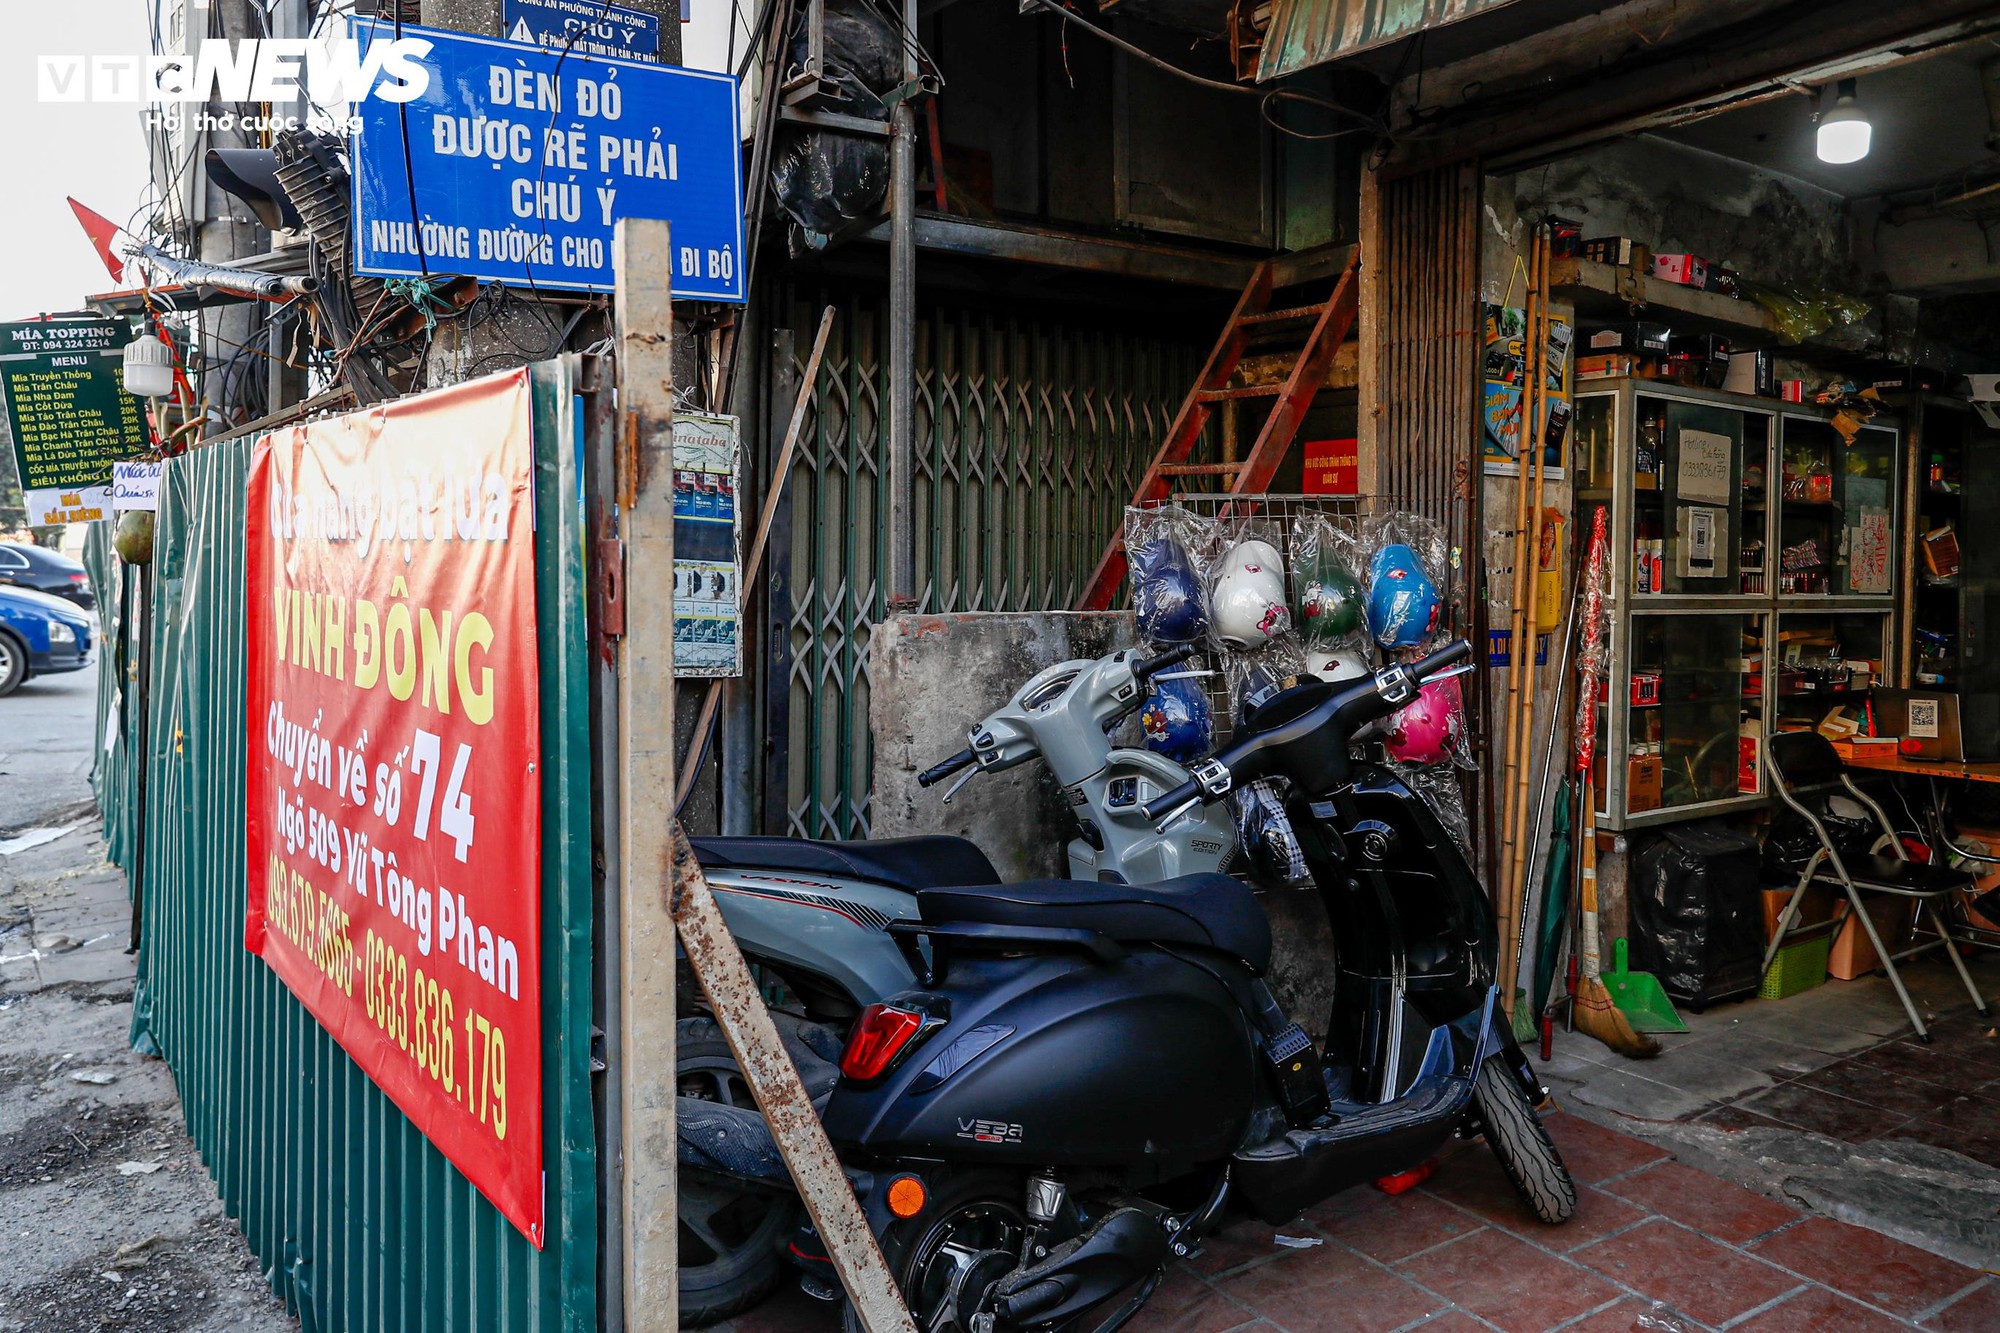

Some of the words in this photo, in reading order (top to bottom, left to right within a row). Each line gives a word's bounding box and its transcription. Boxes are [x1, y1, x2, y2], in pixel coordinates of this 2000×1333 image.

[560, 3, 594, 17] PHƯỜNG
[625, 12, 647, 29] CÔNG
[564, 18, 613, 40] CHÚ
[620, 27, 636, 44] Ý
[488, 58, 562, 114] ĐÈN
[576, 67, 622, 121] ĐỎ
[432, 113, 532, 170] ĐƯỢC
[544, 123, 588, 170] RẼ
[600, 127, 678, 181] PHẢI
[511, 174, 581, 223] CHÚ
[596, 179, 617, 227] Ý
[371, 214, 470, 259] NHƯỜNG
[478, 224, 554, 266] ĐƯỜNG
[562, 236, 604, 269] CHO
[680, 247, 701, 278] ĐI
[708, 244, 734, 288] BỘ
[12, 327, 43, 340] MÍA
[46, 327, 116, 339] TOPPING
[22, 341, 40, 350] ĐT:
[43, 340, 62, 350] 094
[64, 339, 83, 349] 324
[86, 339, 110, 347] 3214
[52, 356, 87, 367] MENU
[114, 368, 124, 376] 10
[54, 381, 78, 389] Châu
[34, 392, 52, 401] Nha
[54, 391, 75, 399] Đam
[119, 397, 135, 405] 15K
[78, 409, 101, 418] Châu
[120, 407, 137, 415] 20K
[39, 421, 57, 431] Đào
[81, 419, 104, 428] Châu
[122, 416, 139, 424] 20K
[41, 432, 59, 442] Bạc
[60, 431, 73, 440] Hà
[96, 427, 119, 436] Châu
[124, 425, 140, 434] 20K
[673, 431, 727, 448] inataba
[43, 441, 72, 451] Chanh
[125, 435, 142, 444] 20K
[29, 463, 44, 474] CỐC
[46, 462, 59, 473] MÍA
[31, 476, 57, 487] SIÊU
[60, 471, 100, 484] KHỔNG
[60, 491, 82, 507] MÍA
[69, 506, 103, 523] RIÊNG
[273, 586, 346, 682] VINH
[354, 575, 495, 727] ĐÔNG
[267, 699, 332, 789] Chuyển
[337, 729, 368, 808] về
[375, 744, 410, 827] số
[410, 728, 476, 864] 74
[1191, 839, 1223, 851] SPORTY
[740, 874, 843, 890] VISION
[276, 785, 305, 856] Ngõ
[307, 807, 342, 874] 509
[343, 825, 369, 898] Vũ
[370, 846, 433, 957] Tông
[439, 886, 520, 1001] Phan
[268, 849, 354, 999] 093.679.5665
[365, 927, 508, 1141] 0333.836.179
